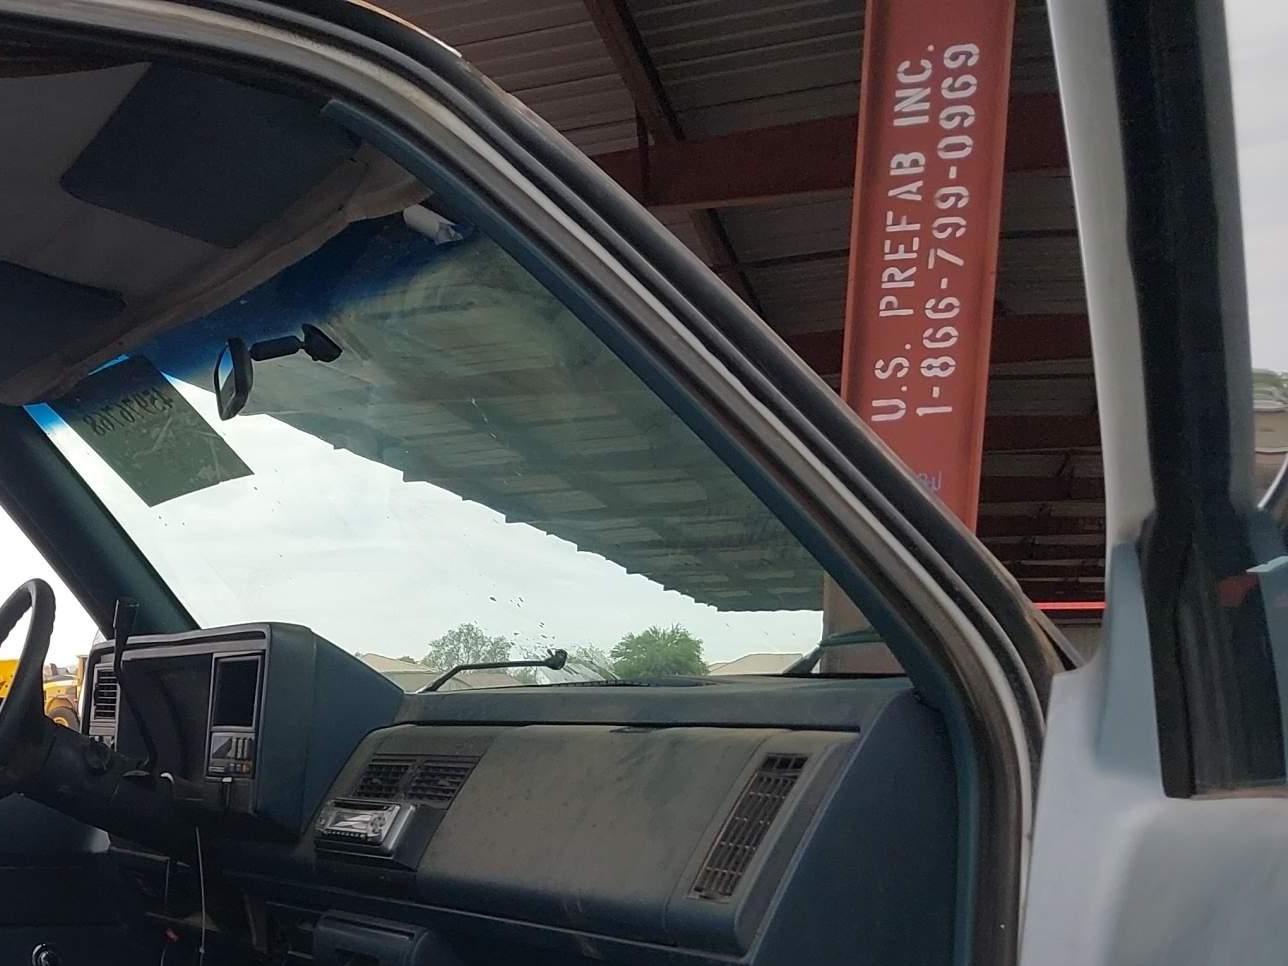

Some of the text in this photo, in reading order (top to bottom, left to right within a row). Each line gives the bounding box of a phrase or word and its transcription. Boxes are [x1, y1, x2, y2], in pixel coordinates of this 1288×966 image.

[870, 43, 936, 422] U.S. PREFAB INC.
[916, 41, 981, 418] 1-866-799-0969
